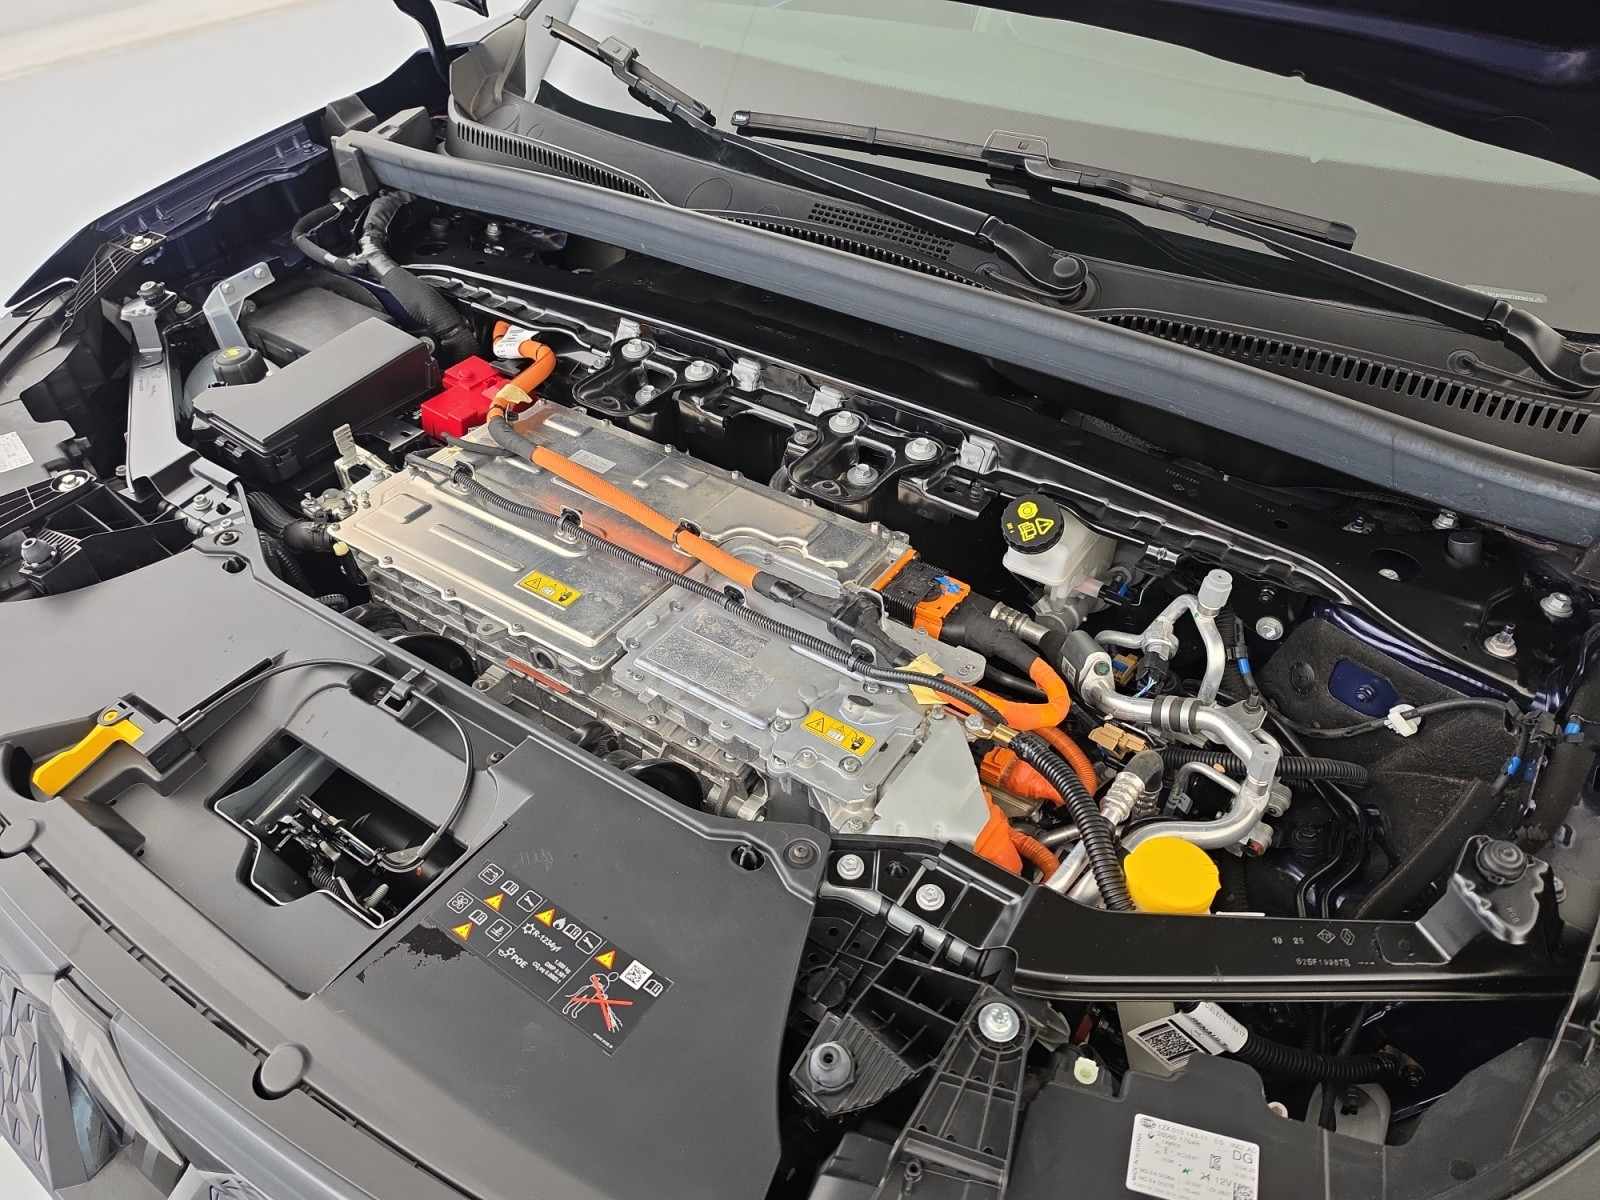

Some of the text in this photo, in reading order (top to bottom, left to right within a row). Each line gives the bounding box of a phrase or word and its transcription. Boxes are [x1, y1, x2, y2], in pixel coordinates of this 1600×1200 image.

[532, 930, 562, 952] R-1234yf
[511, 954, 528, 969] POE
[1232, 1150, 1253, 1163] DG
[1215, 1176, 1232, 1186] 12V
